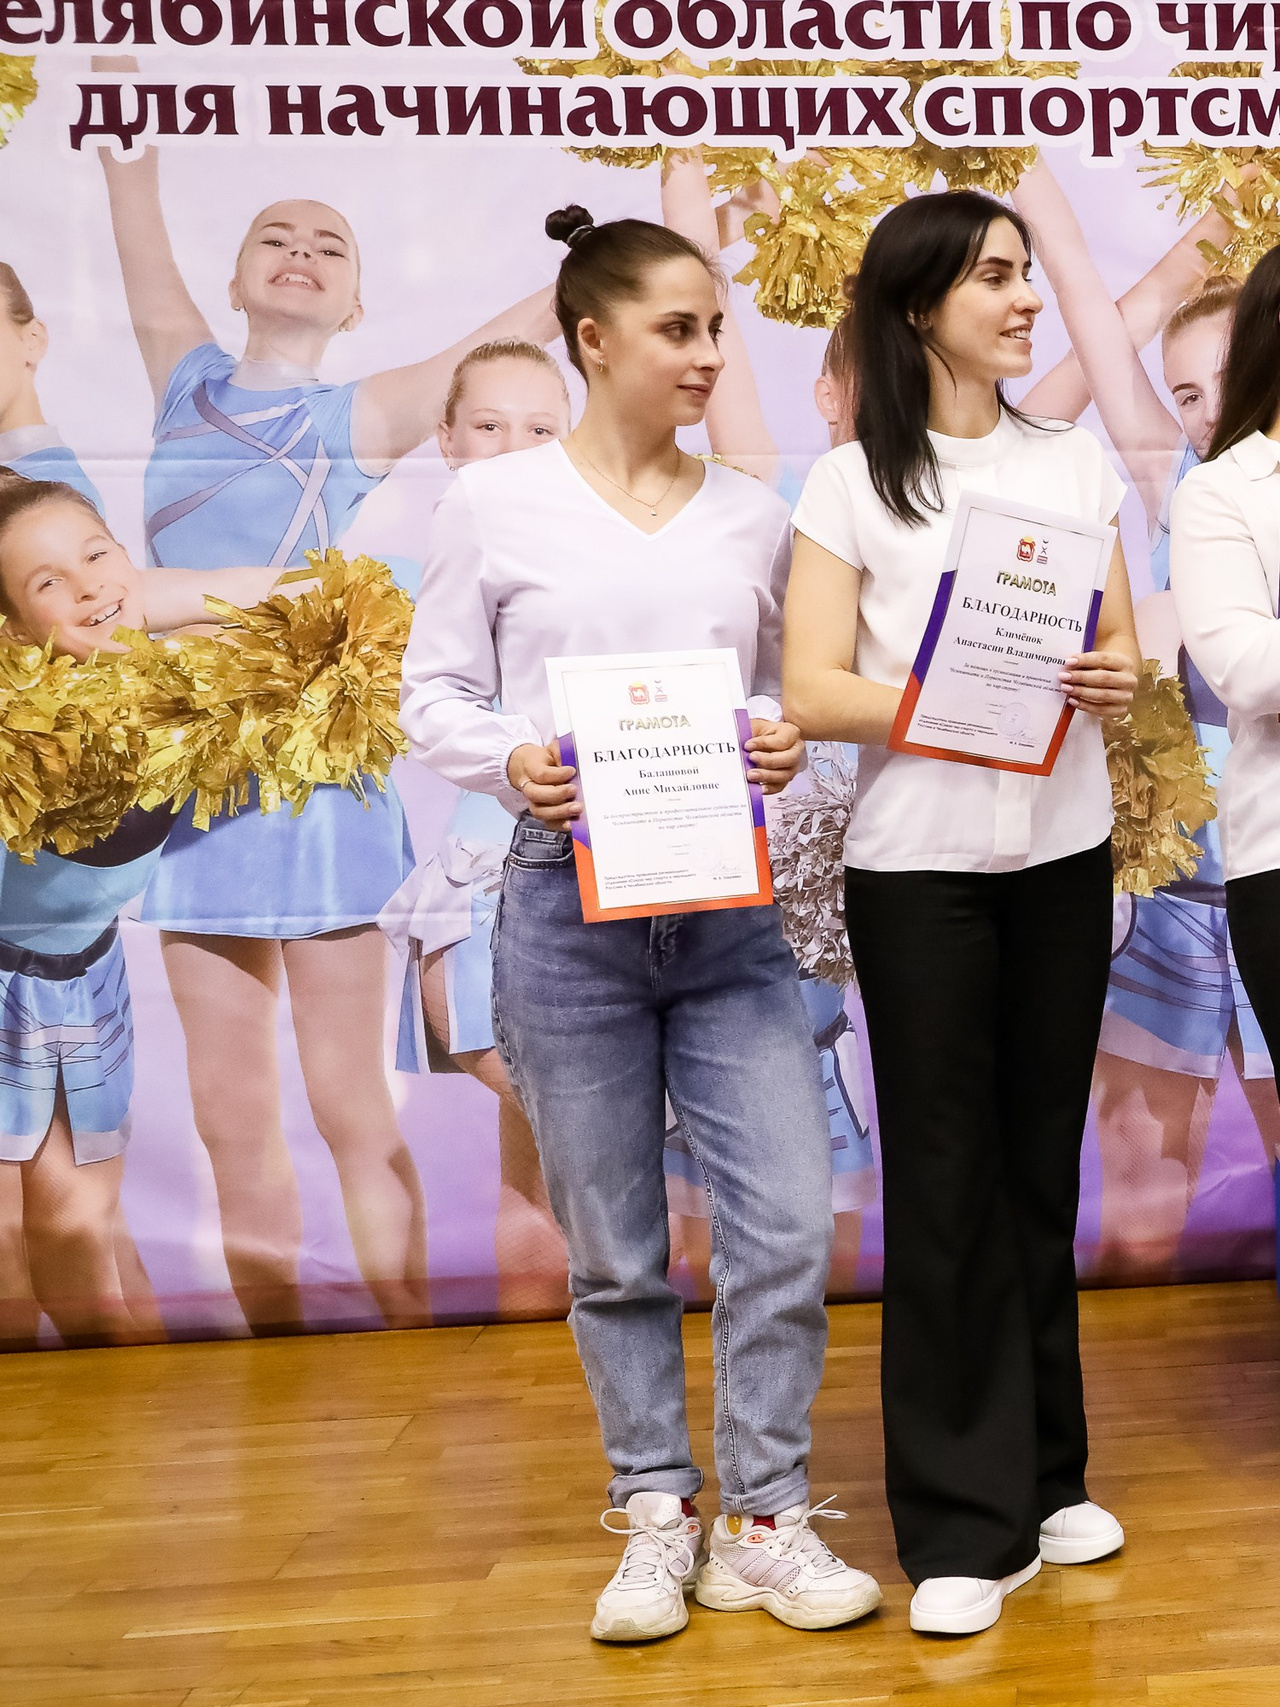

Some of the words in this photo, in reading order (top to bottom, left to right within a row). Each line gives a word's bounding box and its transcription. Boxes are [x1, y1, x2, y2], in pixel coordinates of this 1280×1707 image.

[614, 0, 992, 50] области
[1019, 1, 1132, 51] по
[69, 84, 239, 151] для
[265, 84, 903, 151] начинающих
[996, 569, 1057, 597] ГРАМОТА
[962, 596, 1083, 634] БЛАГОДАРНОСТЬ
[995, 626, 1043, 645] Климёнок
[953, 636, 1004, 654] Анастасии
[1005, 646, 1067, 667] Владимиров
[618, 714, 691, 732] ГРАМОТА
[593, 742, 737, 764] БЛАГОДАРНОСТЬ
[639, 765, 699, 778] Балашовой
[654, 780, 719, 794] Михайловне
